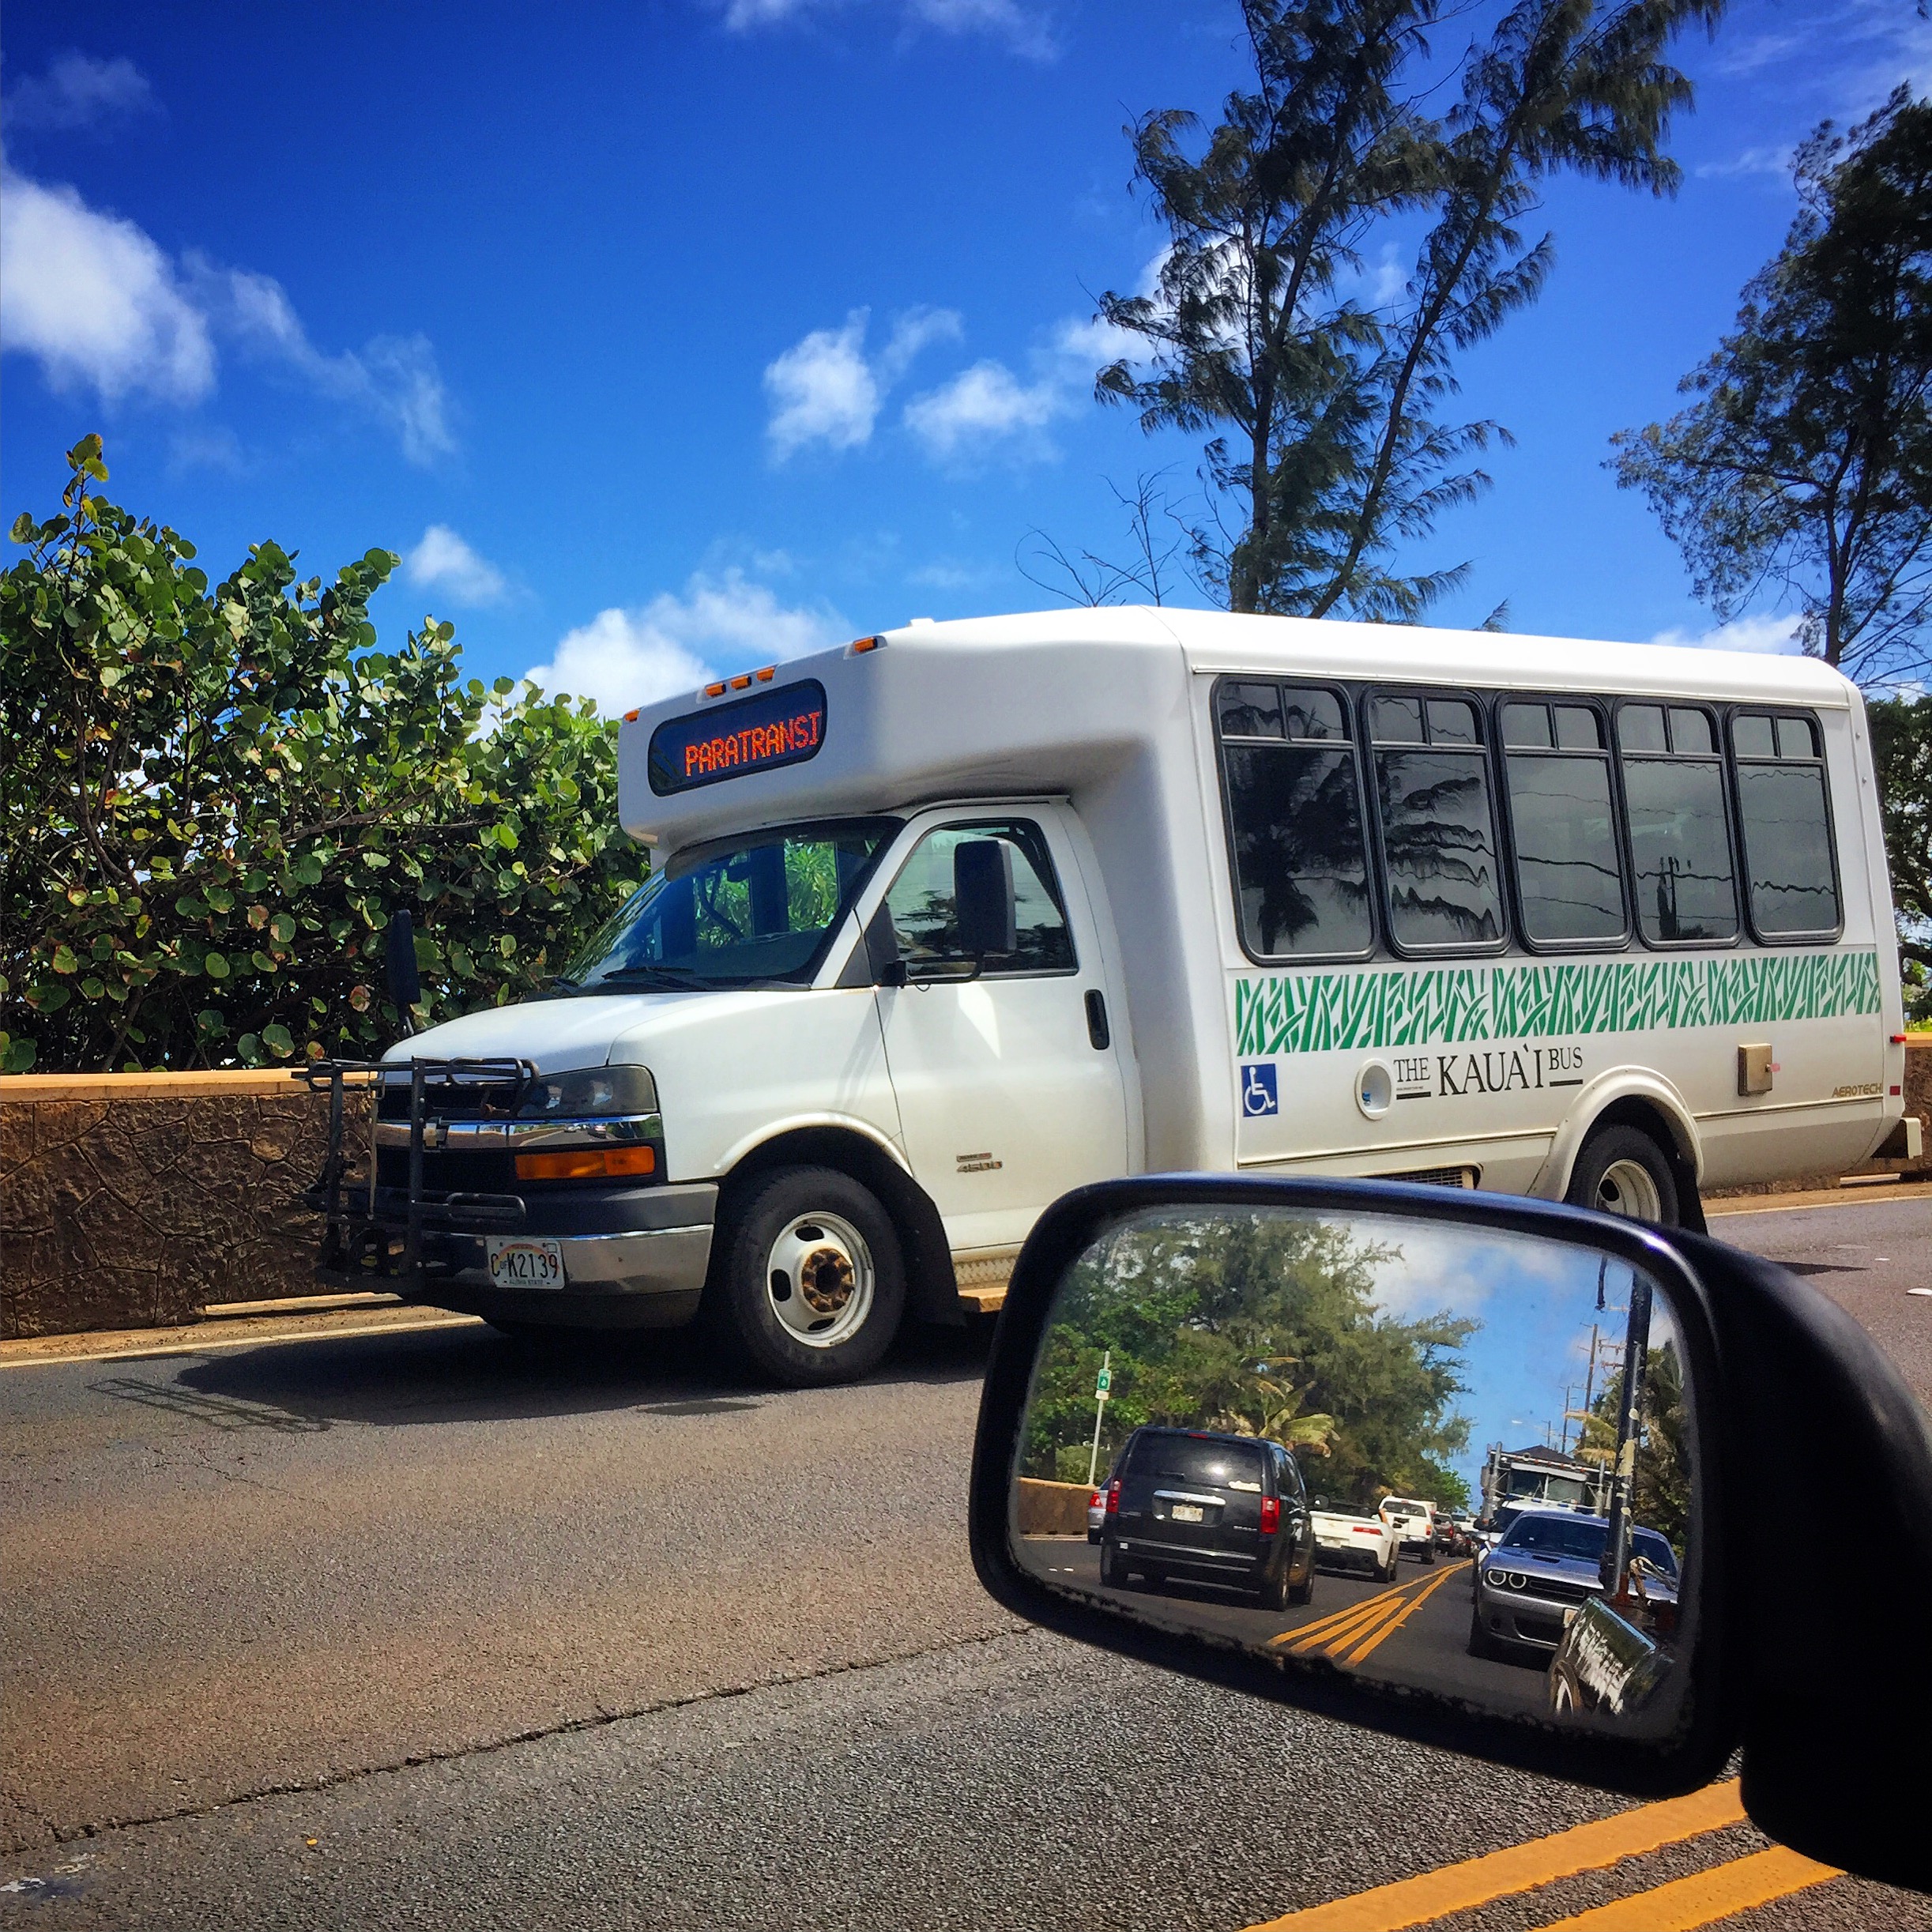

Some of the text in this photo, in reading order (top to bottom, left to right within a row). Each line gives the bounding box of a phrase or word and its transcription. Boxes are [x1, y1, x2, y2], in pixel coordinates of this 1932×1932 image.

[685, 711, 820, 777] PARATRANSI
[1394, 1057, 1430, 1083] THE
[1548, 1046, 1584, 1071] BUS
[1832, 1082, 1883, 1098] AEROTECH
